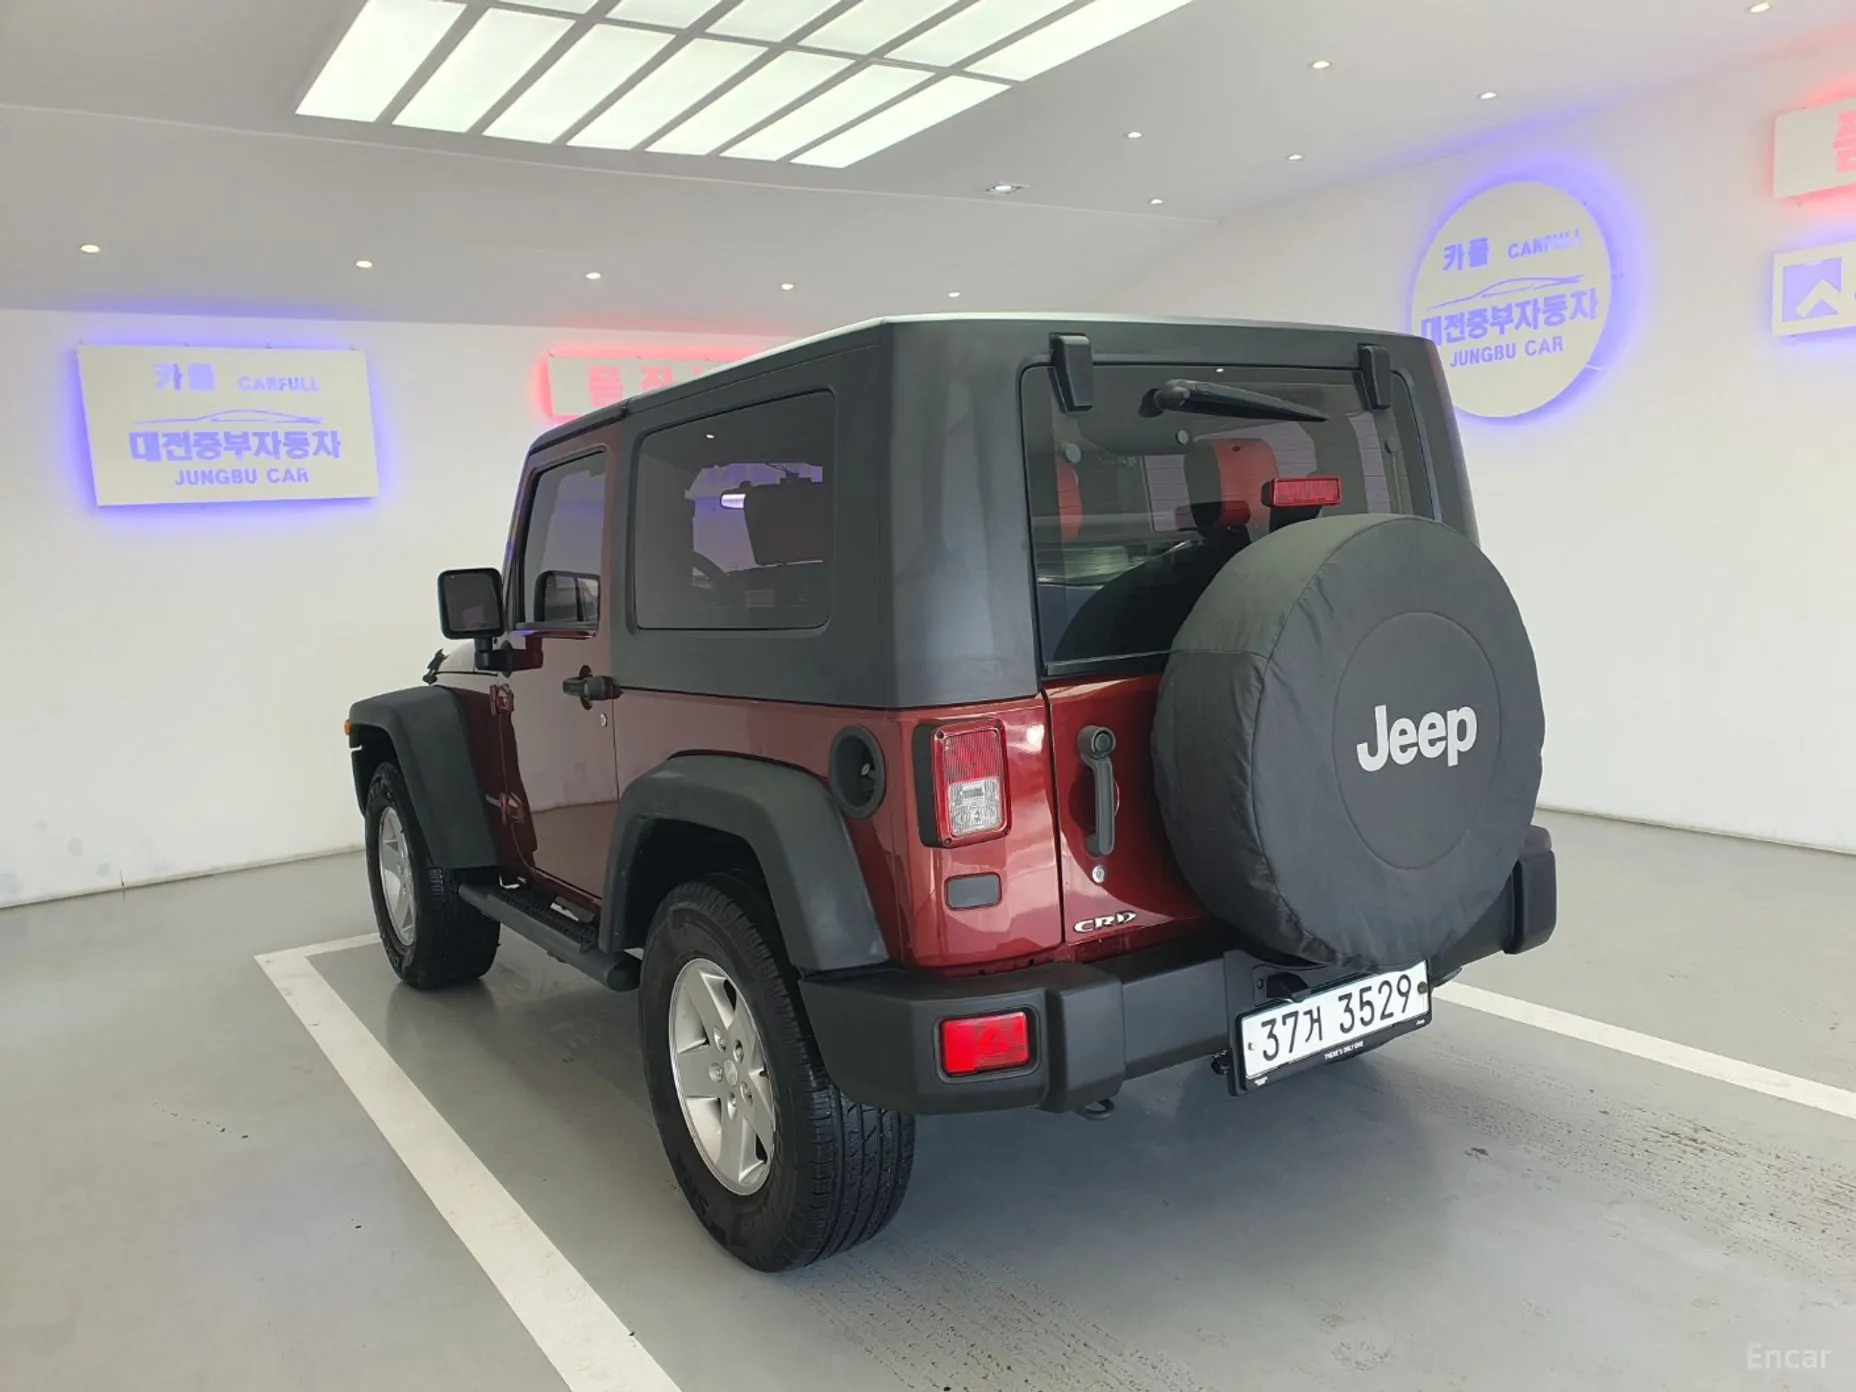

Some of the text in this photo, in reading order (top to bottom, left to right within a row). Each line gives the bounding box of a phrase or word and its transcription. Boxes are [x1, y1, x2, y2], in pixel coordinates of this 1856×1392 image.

[1443, 237, 1489, 271] 카
[1450, 336, 1564, 368] JUNGBU CAR
[154, 363, 215, 391] 카
[174, 468, 309, 486] JUNGBU CAR
[1356, 704, 1478, 772] Jeep
[1073, 911, 1137, 933] CRD
[1260, 973, 1412, 1062] 37거 3529
